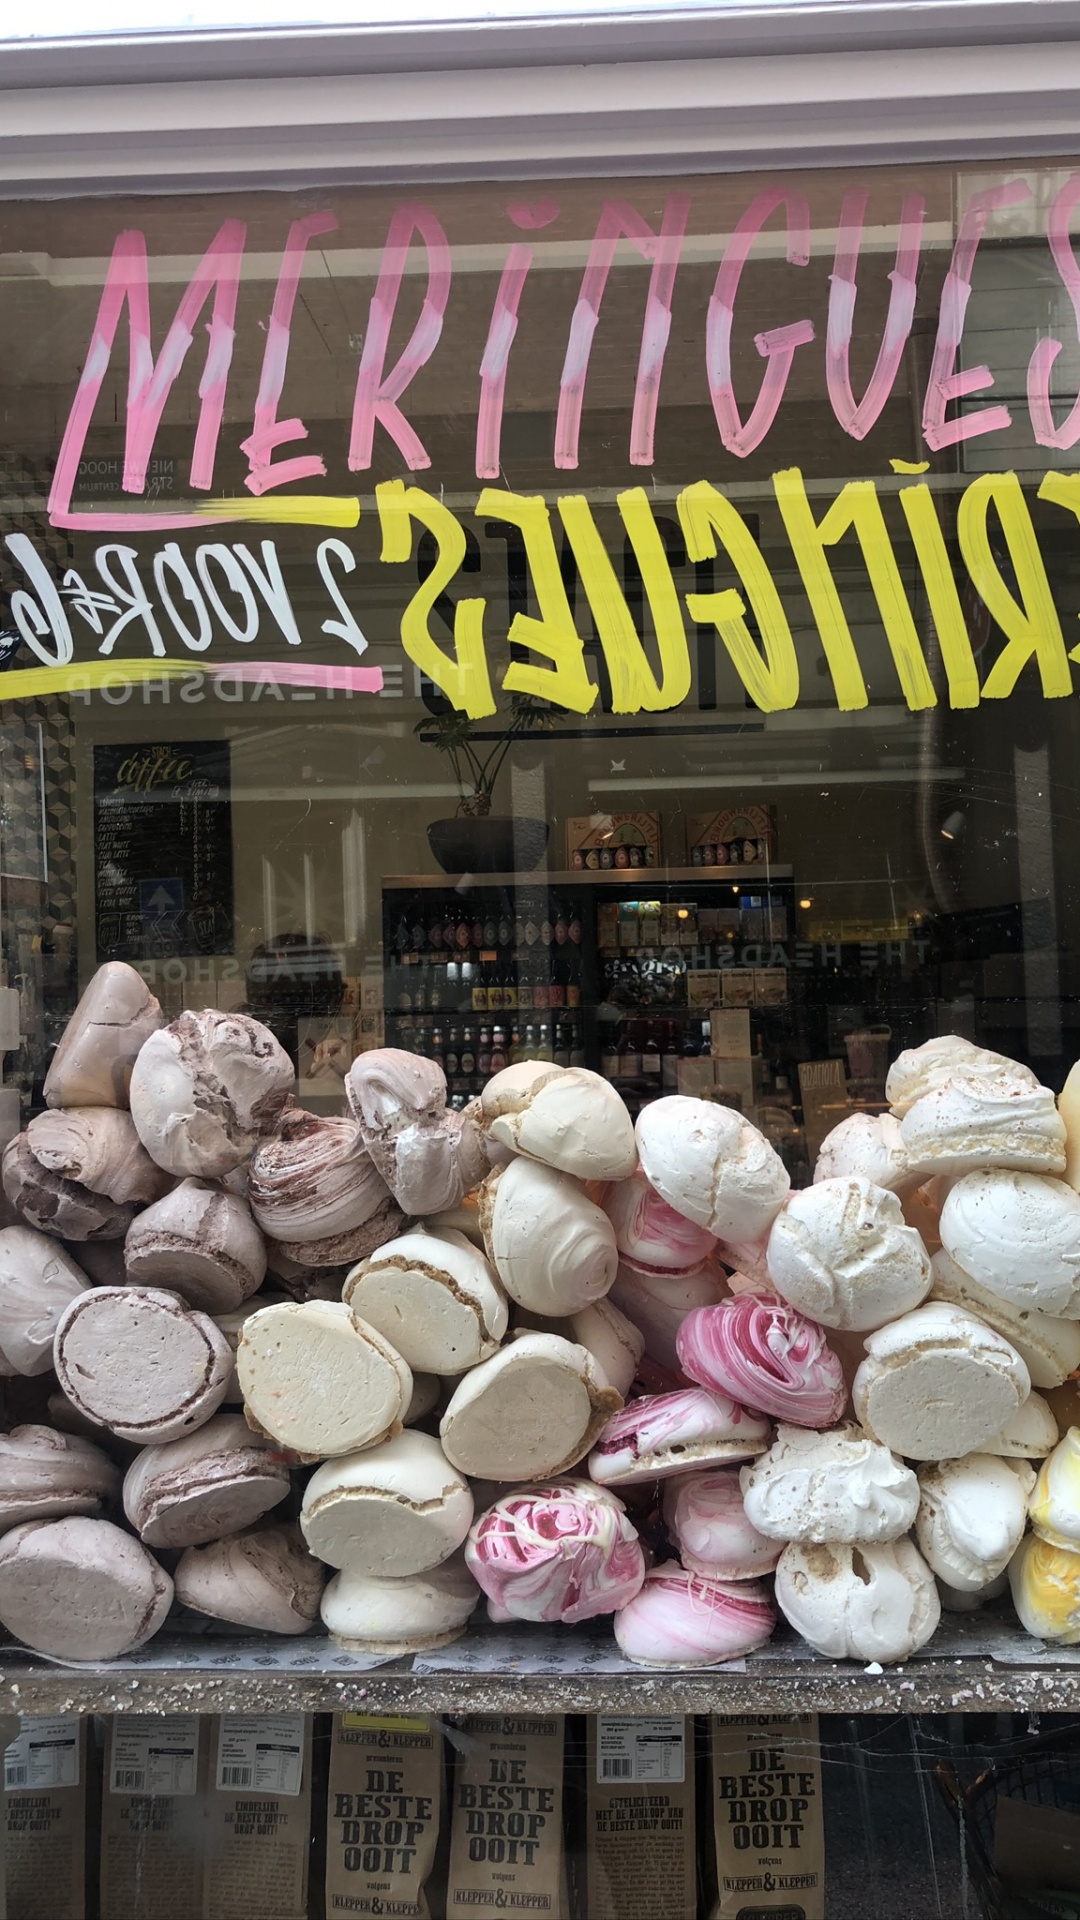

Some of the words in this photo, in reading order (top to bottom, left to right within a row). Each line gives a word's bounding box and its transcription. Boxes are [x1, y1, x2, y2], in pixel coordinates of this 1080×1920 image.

[393, 1734, 432, 1747] KLEPPER
[489, 1759, 527, 1784] DE
[747, 1748, 785, 1772] DE
[366, 1770, 403, 1793] DE
[719, 1772, 816, 1799] BESTE
[334, 1794, 432, 1820] BESTE
[458, 1784, 554, 1812] BESTE
[728, 1798, 809, 1823] DROP
[237, 1812, 262, 1823] BESTE
[466, 1810, 546, 1838] DROP
[596, 1809, 614, 1820] MET
[667, 1807, 684, 1819] VAN
[597, 1821, 608, 1832] DE
[610, 1820, 635, 1832] BESTE
[341, 1820, 424, 1846] DROP
[733, 1824, 804, 1850] OOIT
[344, 1847, 417, 1873] OOIT
[469, 1836, 540, 1866] OOIT
[725, 1877, 763, 1891] KLEPPER
[763, 1872, 776, 1892] &
[779, 1874, 816, 1888] KLEPPER
[456, 1891, 494, 1904] KLEPPER
[495, 1888, 508, 1908] &
[510, 1893, 549, 1908] KLEPPER
